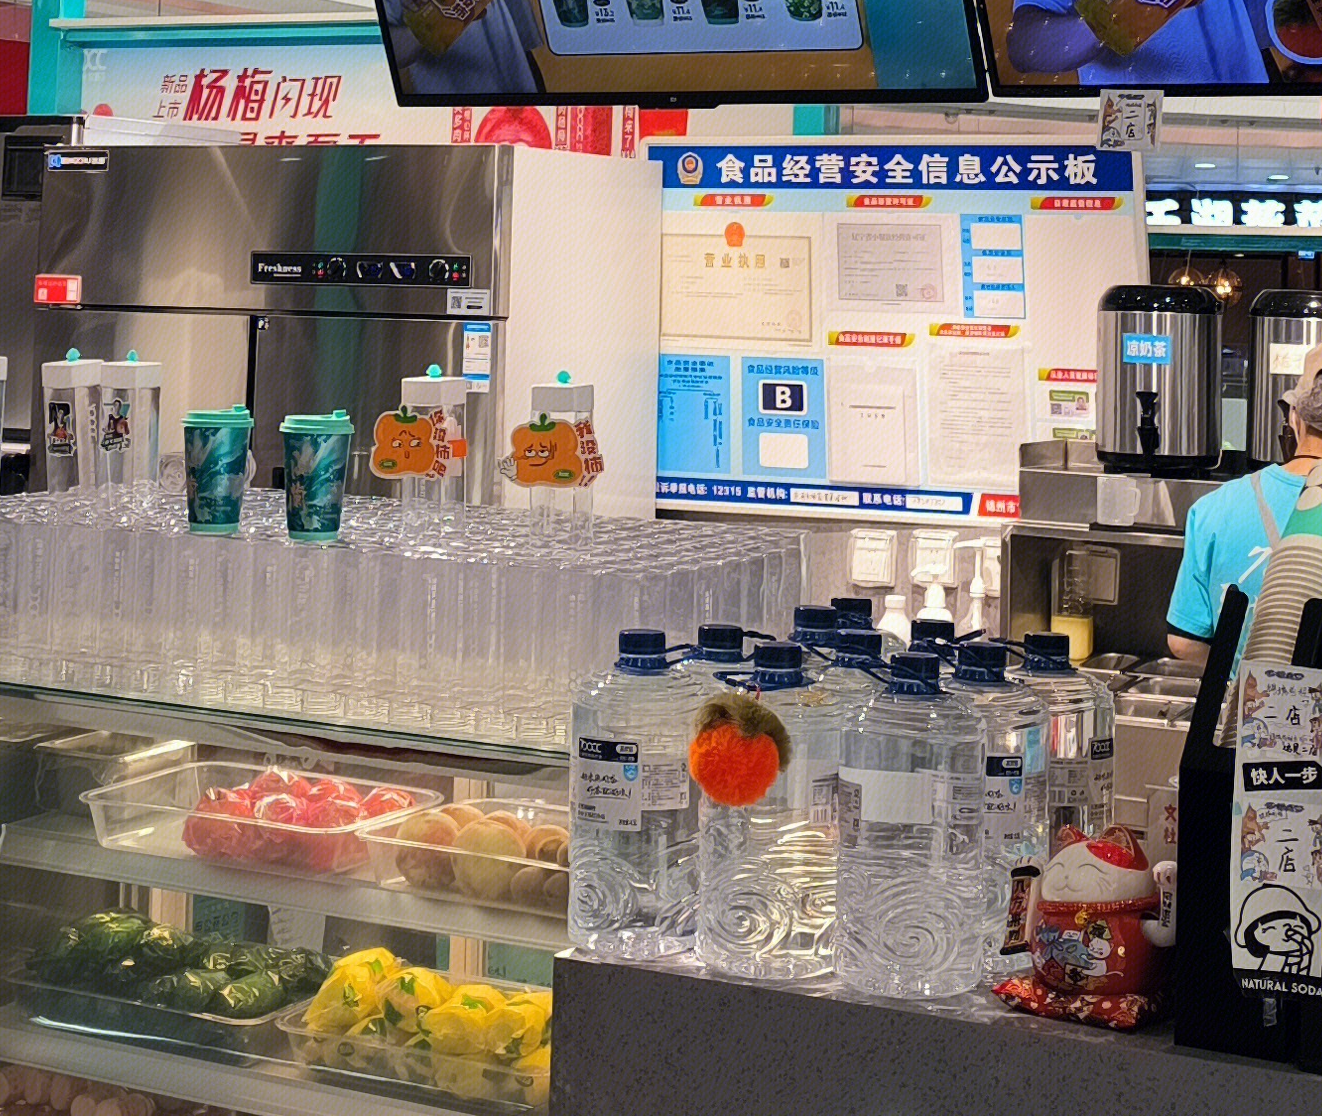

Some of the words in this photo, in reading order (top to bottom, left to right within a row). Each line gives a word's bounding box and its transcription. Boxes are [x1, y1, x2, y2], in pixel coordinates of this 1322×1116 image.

[160, 73, 188, 95] 新品
[182, 67, 342, 123] 杨梅闪现
[152, 100, 182, 120] 上市
[715, 151, 1099, 186] 食品经营安全信息公示板
[703, 252, 766, 269] 营业执照
[775, 385, 792, 409] B
[1250, 766, 1318, 786] 快人一步
[1276, 826, 1299, 874] 二店
[1241, 976, 1289, 994] NATURAL
